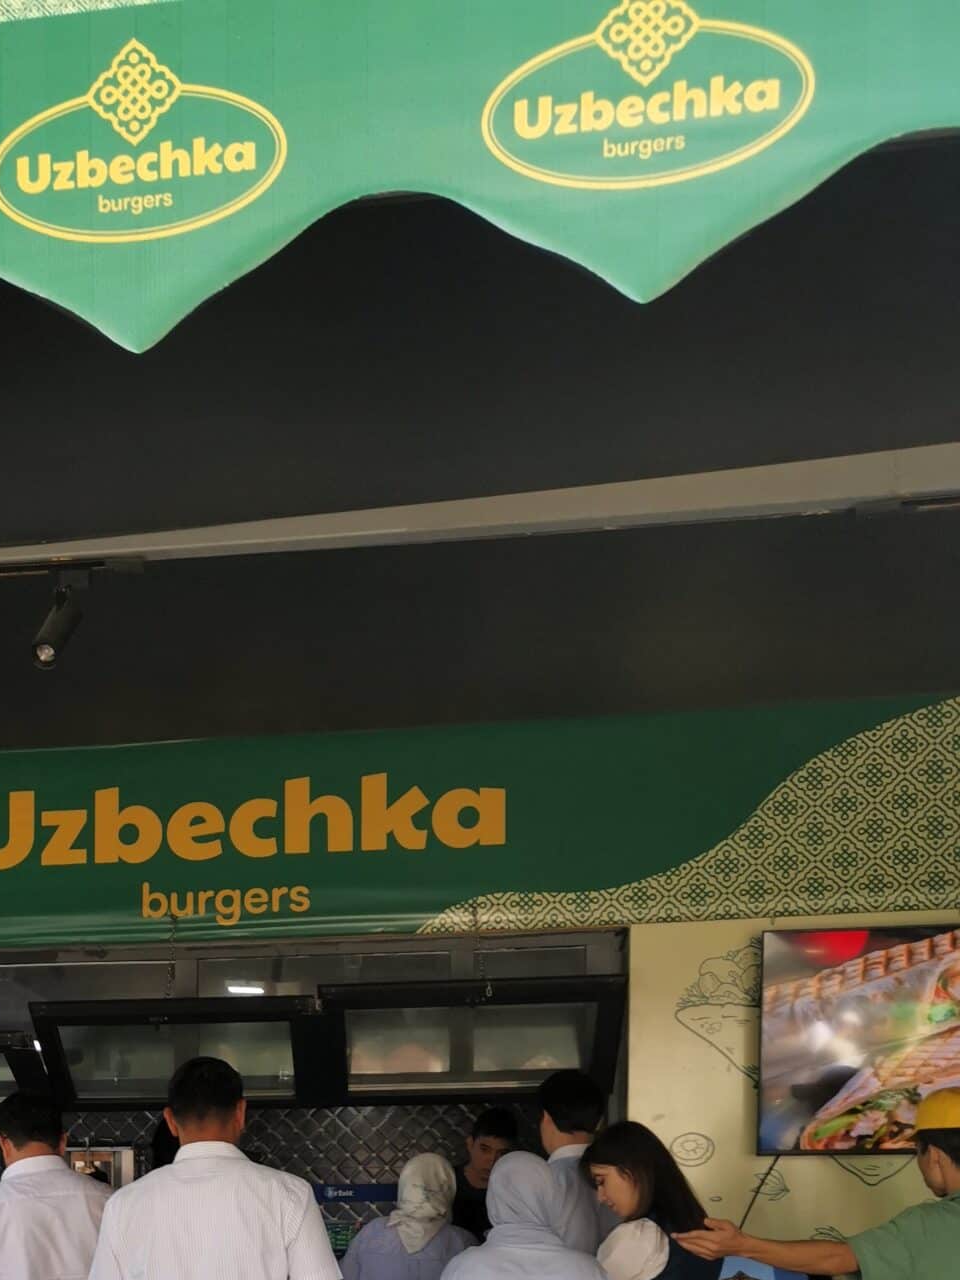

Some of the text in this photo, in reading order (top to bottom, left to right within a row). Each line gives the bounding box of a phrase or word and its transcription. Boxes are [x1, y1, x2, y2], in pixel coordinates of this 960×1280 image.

[513, 76, 780, 139] Uzbechka
[15, 138, 256, 194] Uzbechka
[603, 135, 685, 158] burgers
[98, 192, 173, 213] burgers
[141, 883, 311, 926] burgers
